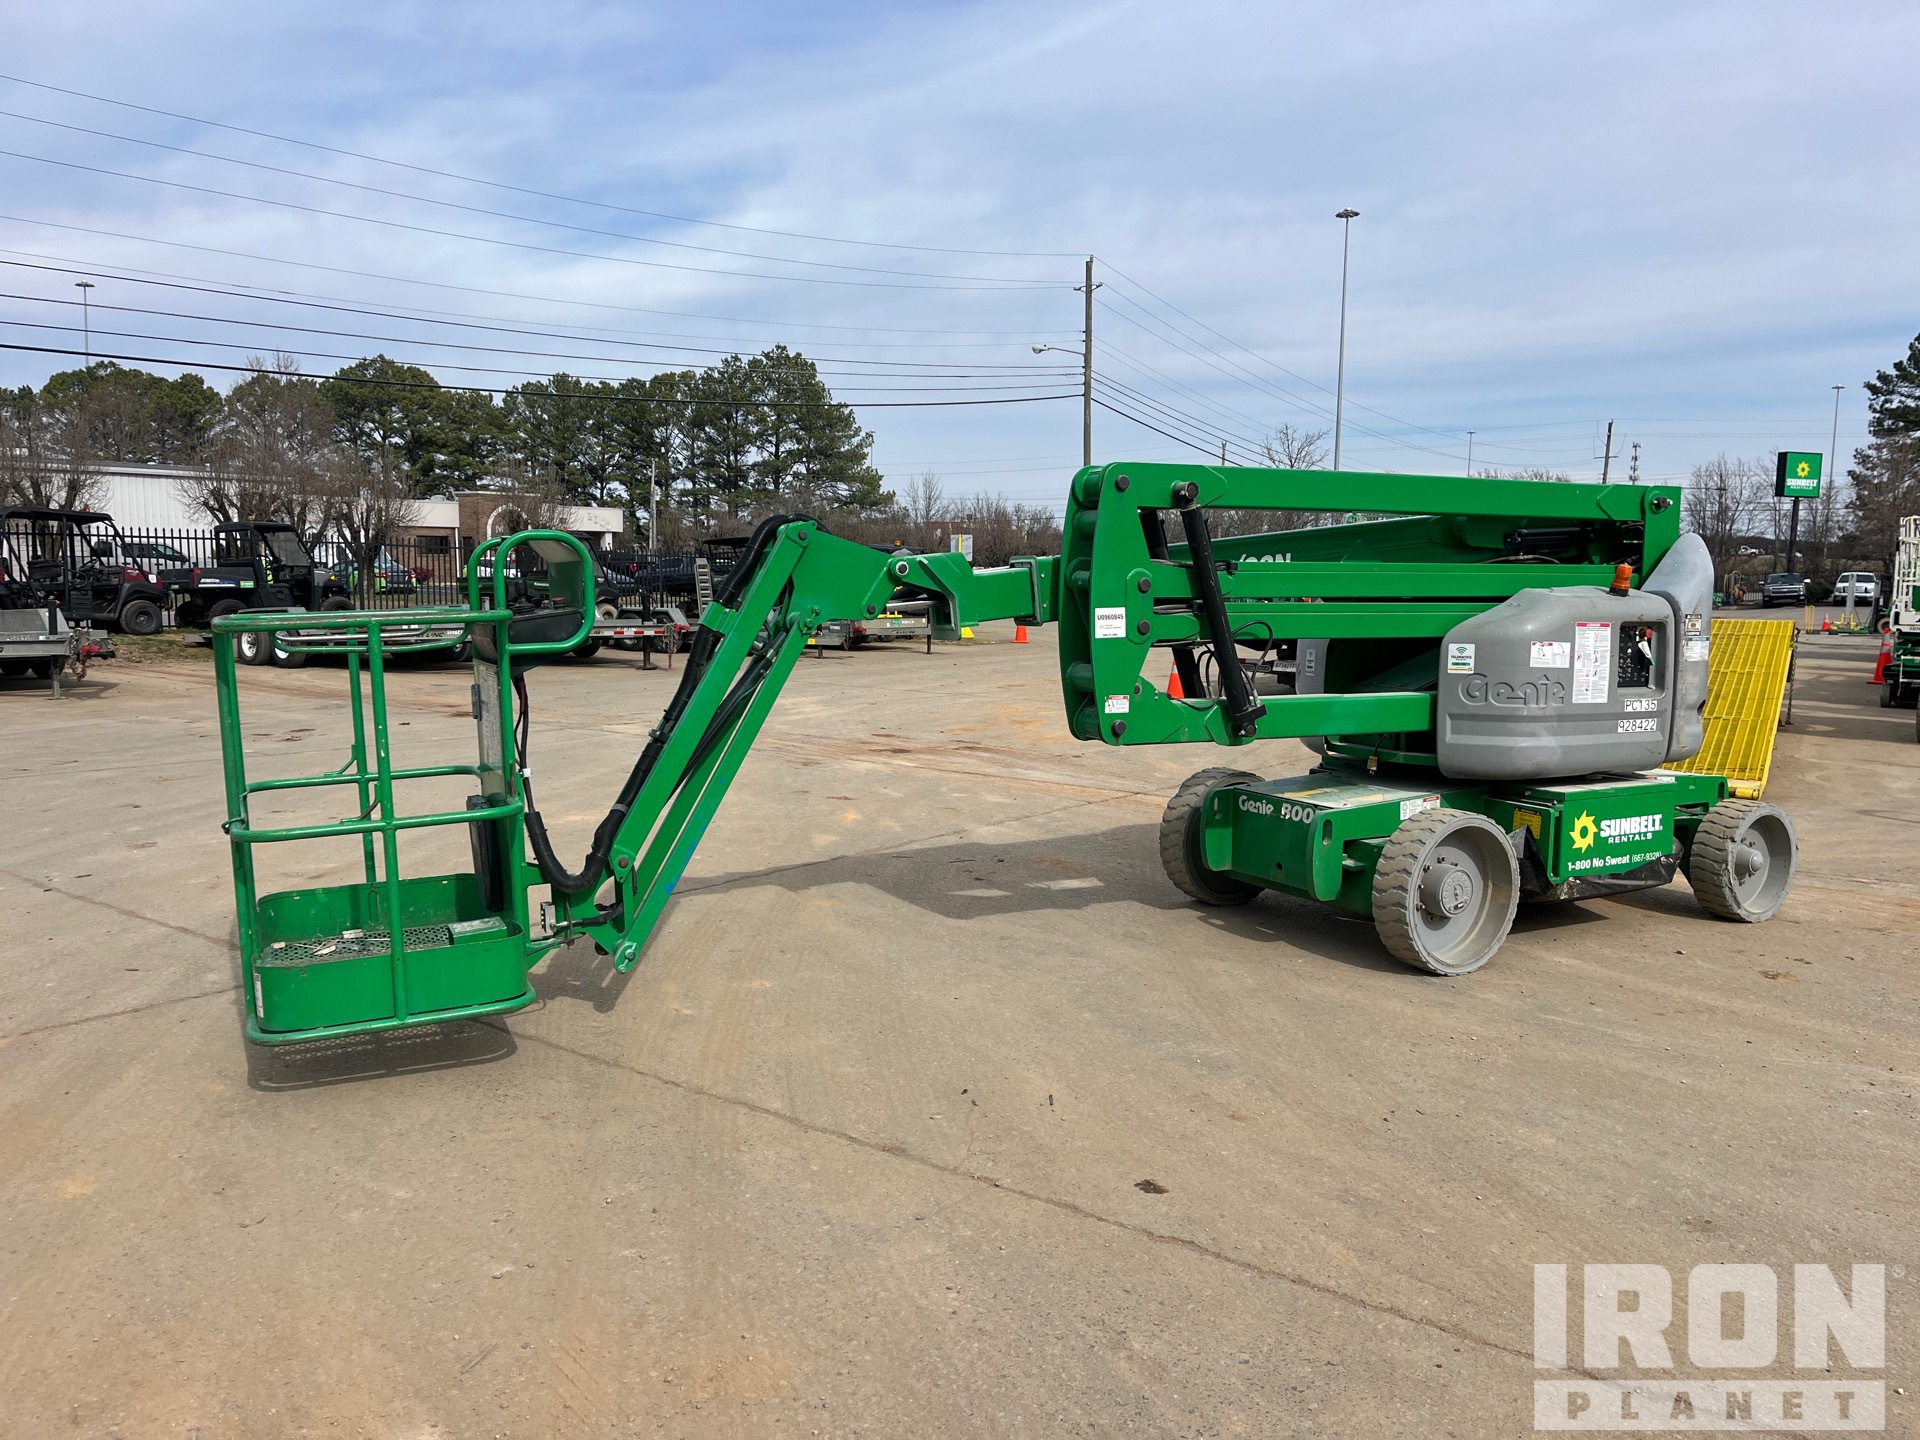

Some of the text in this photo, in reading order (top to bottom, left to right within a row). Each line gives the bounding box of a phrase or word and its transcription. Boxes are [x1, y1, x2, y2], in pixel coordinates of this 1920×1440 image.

[1786, 478, 1818, 487] SUNBELT
[1458, 673, 1566, 707] Genie
[1625, 700, 1657, 711] PC135
[1618, 719, 1656, 732] 928422
[1238, 795, 1274, 815] Genie
[1599, 814, 1662, 837] SUNBELT
[1608, 832, 1653, 844] RENTALS
[1567, 859, 1591, 871] 1-800
[1592, 857, 1604, 868] No
[1605, 854, 1630, 866] Sweat
